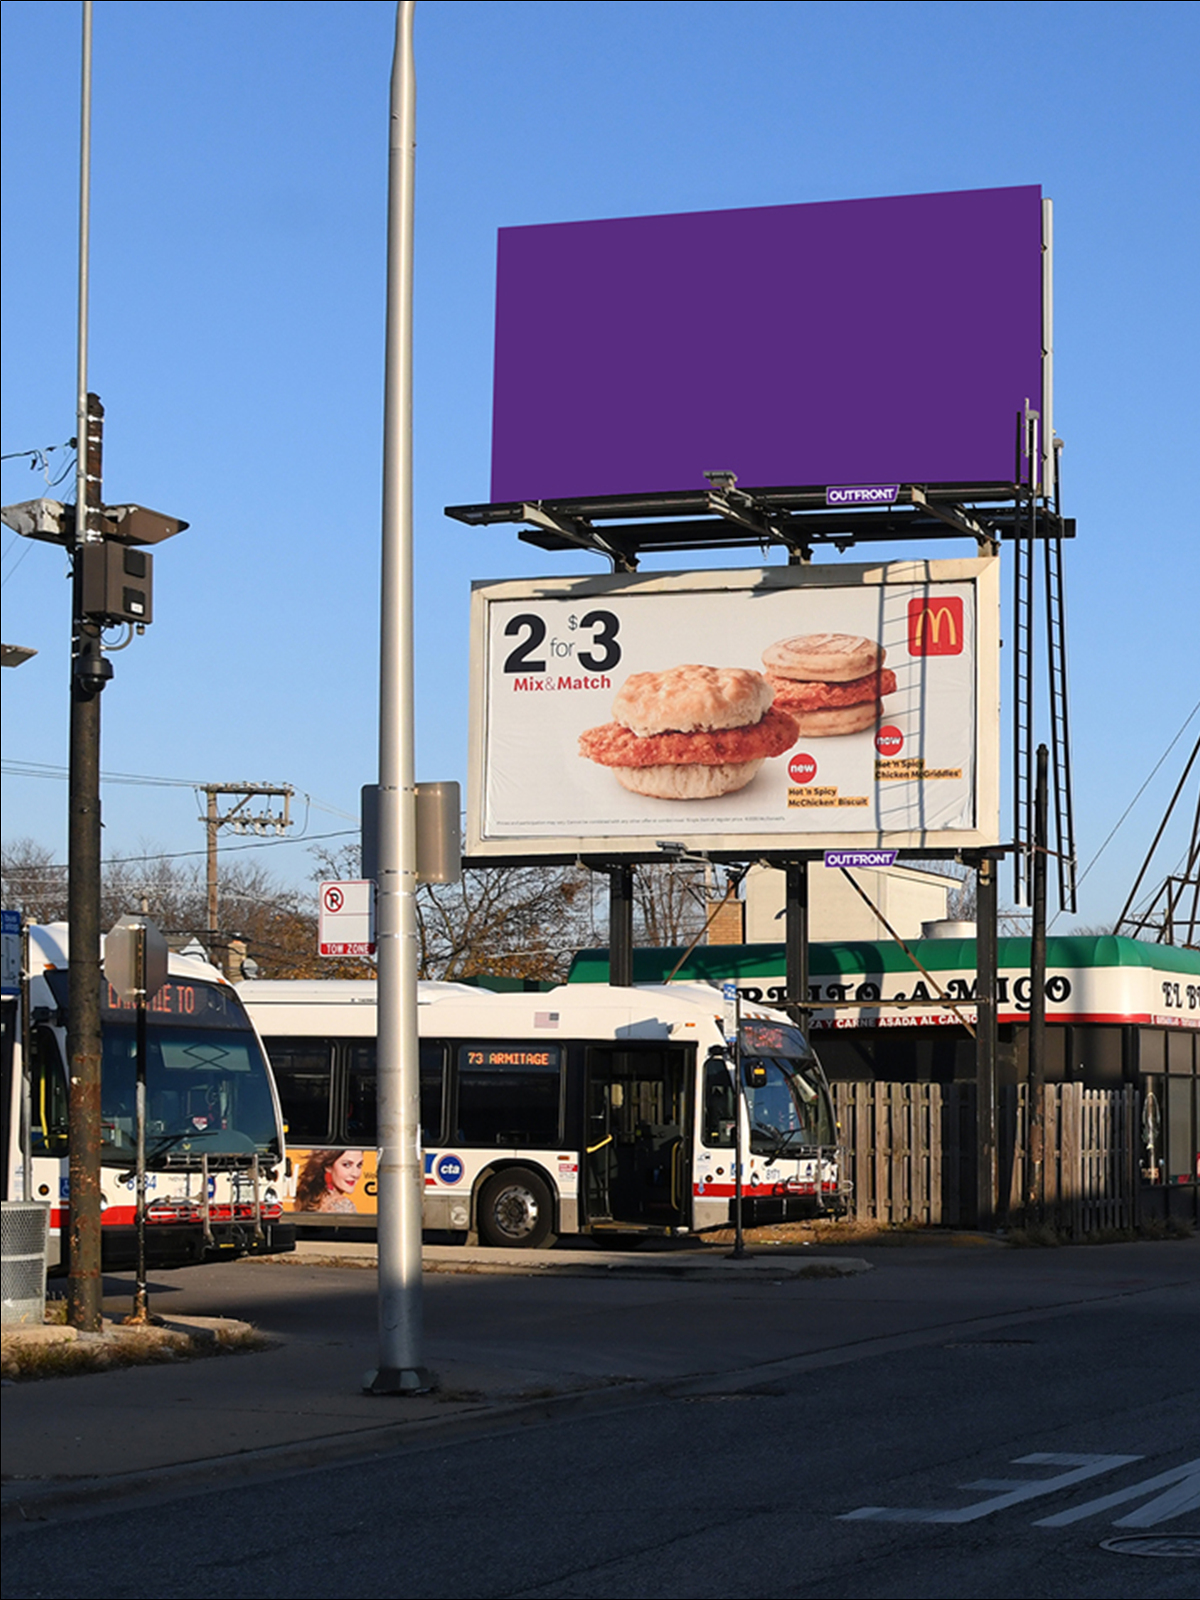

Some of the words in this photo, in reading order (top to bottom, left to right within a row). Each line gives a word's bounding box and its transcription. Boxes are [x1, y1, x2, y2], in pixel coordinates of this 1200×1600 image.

[829, 488, 894, 501] OUTFRONT
[503, 613, 546, 673] 2
[550, 637, 575, 657] for
[876, 737, 901, 745] new
[790, 764, 815, 773] new
[902, 759, 924, 769] Spicy
[876, 770, 909, 779] Chicken
[788, 788, 801, 796] Hot
[814, 788, 837, 797] Spicy
[838, 798, 868, 806] Biscuit
[827, 853, 893, 866] OUTFRONT
[326, 943, 344, 955] TOW
[346, 943, 370, 955] ZONE
[176, 985, 195, 1014] TO
[1162, 981, 1183, 1009] EL
[836, 1018, 876, 1029] CARNE
[878, 1016, 918, 1027] ASADA
[920, 1016, 936, 1026] AL
[938, 1014, 978, 1025] CARBO
[468, 1052, 484, 1065] 73
[489, 1052, 550, 1066] ARMITAGE
[440, 1163, 460, 1175] cta
